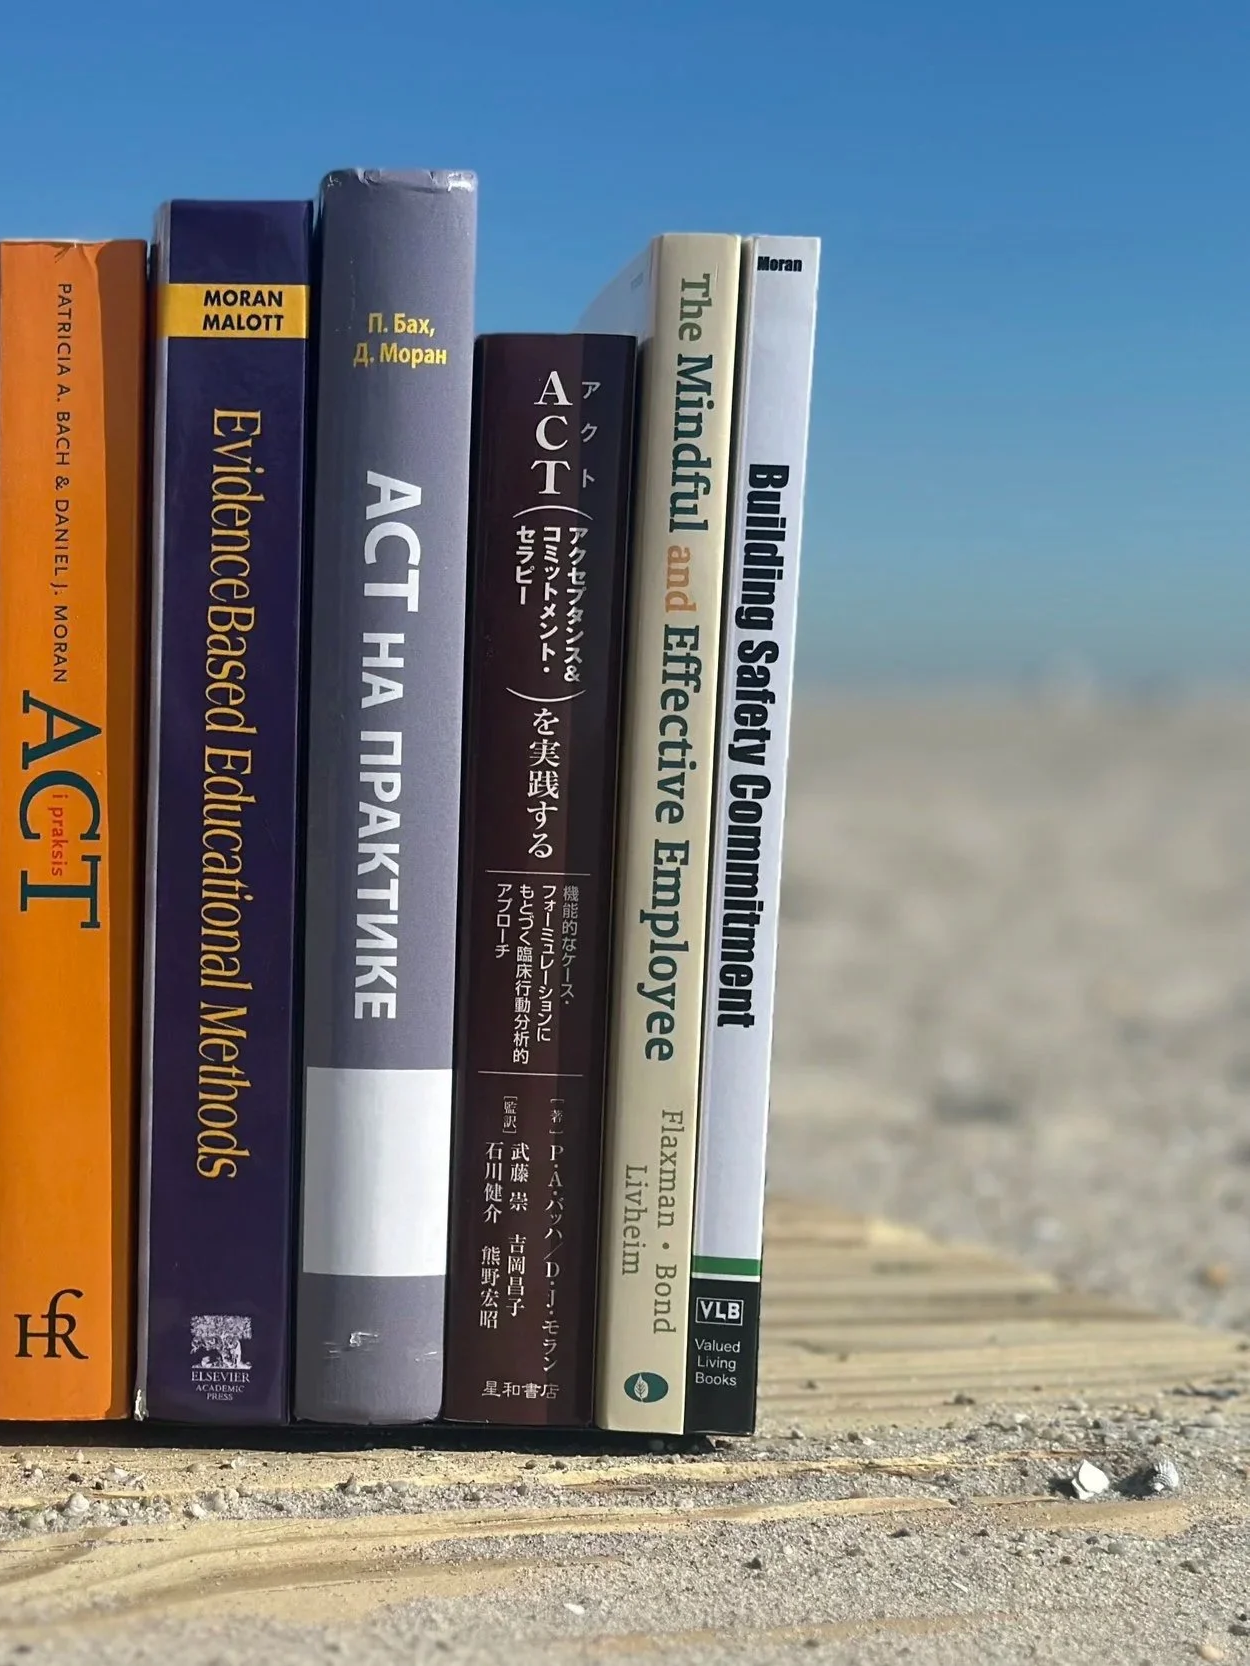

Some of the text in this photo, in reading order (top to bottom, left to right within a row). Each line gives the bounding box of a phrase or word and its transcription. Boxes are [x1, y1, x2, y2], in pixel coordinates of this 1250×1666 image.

[203, 289, 283, 307] MORAN
[756, 255, 803, 273] Moran
[202, 313, 285, 332] MALOTT
[352, 342, 447, 369] Д. Моран
[368, 312, 436, 338] П. Бах,
[530, 369, 574, 496] ACT
[580, 380, 601, 490] アクト
[53, 282, 72, 683] PATRICIA A. BACH & DANIEL MORAN
[514, 525, 535, 606] セラピー
[360, 631, 406, 709] НА
[636, 273, 715, 1063] The Mindful and Effective Employee
[526, 706, 561, 859] を実践する
[717, 463, 790, 1029] Building Safety Commitment
[19, 689, 103, 930] ACT
[47, 805, 69, 878] praksis
[198, 744, 257, 992] Educational
[354, 730, 404, 1020] ПРАКТИКЕ
[494, 883, 513, 960] アプローチ
[512, 883, 535, 1065] もとづく臨床行動分析的
[536, 884, 557, 1043] フォーミュレーションに
[195, 1001, 252, 1180] Methods
[479, 1140, 504, 1330] 石川健介 熊野宏昭
[621, 1163, 648, 1276] Livheim
[652, 1109, 684, 1335] Flaxman Bond
[505, 1232, 527, 1318] 吉岡昌子
[699, 1300, 741, 1321] VLB
[191, 1371, 251, 1383] ELSEVIER
[694, 1337, 741, 1354] Valued
[694, 1371, 738, 1387] Books
[696, 1354, 737, 1373] Living
[195, 1383, 245, 1394] ACADEMIC
[206, 1392, 233, 1401] PRESS
[481, 1380, 560, 1400] 星和書店
